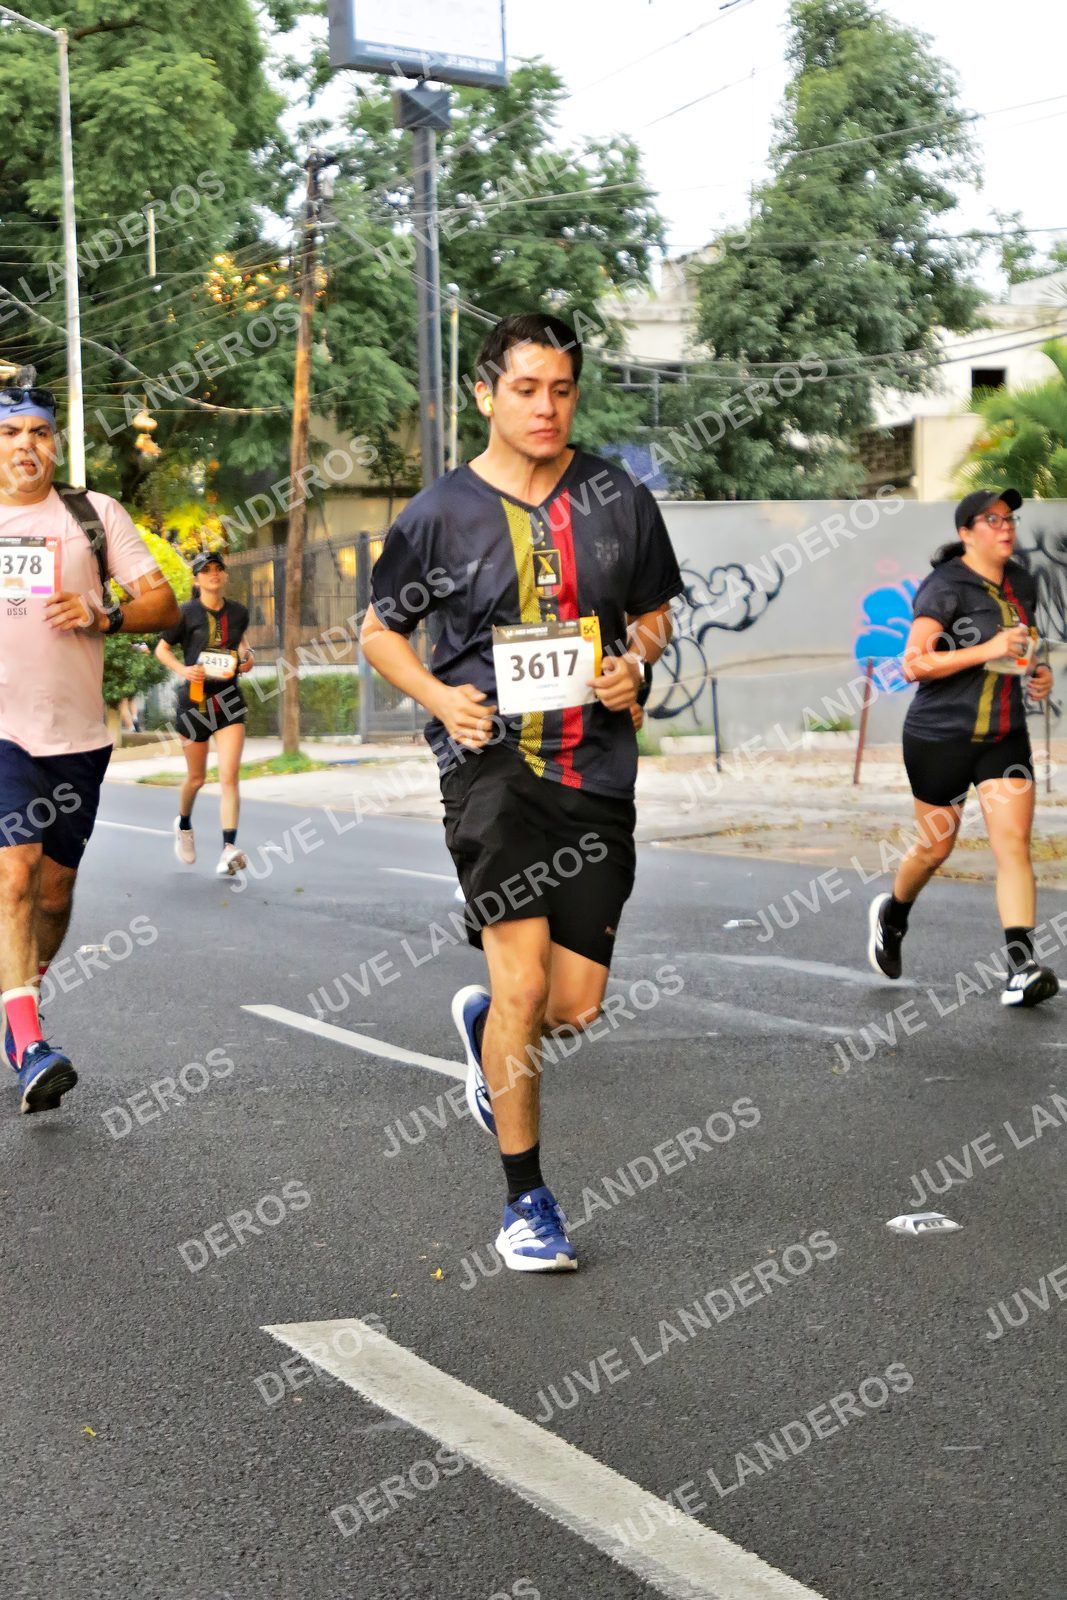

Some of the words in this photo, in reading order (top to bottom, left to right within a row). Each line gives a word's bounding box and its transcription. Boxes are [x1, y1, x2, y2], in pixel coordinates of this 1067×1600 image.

[0, 555, 42, 575] 378
[205, 655, 230, 668] 2413
[510, 648, 579, 682] 3617
